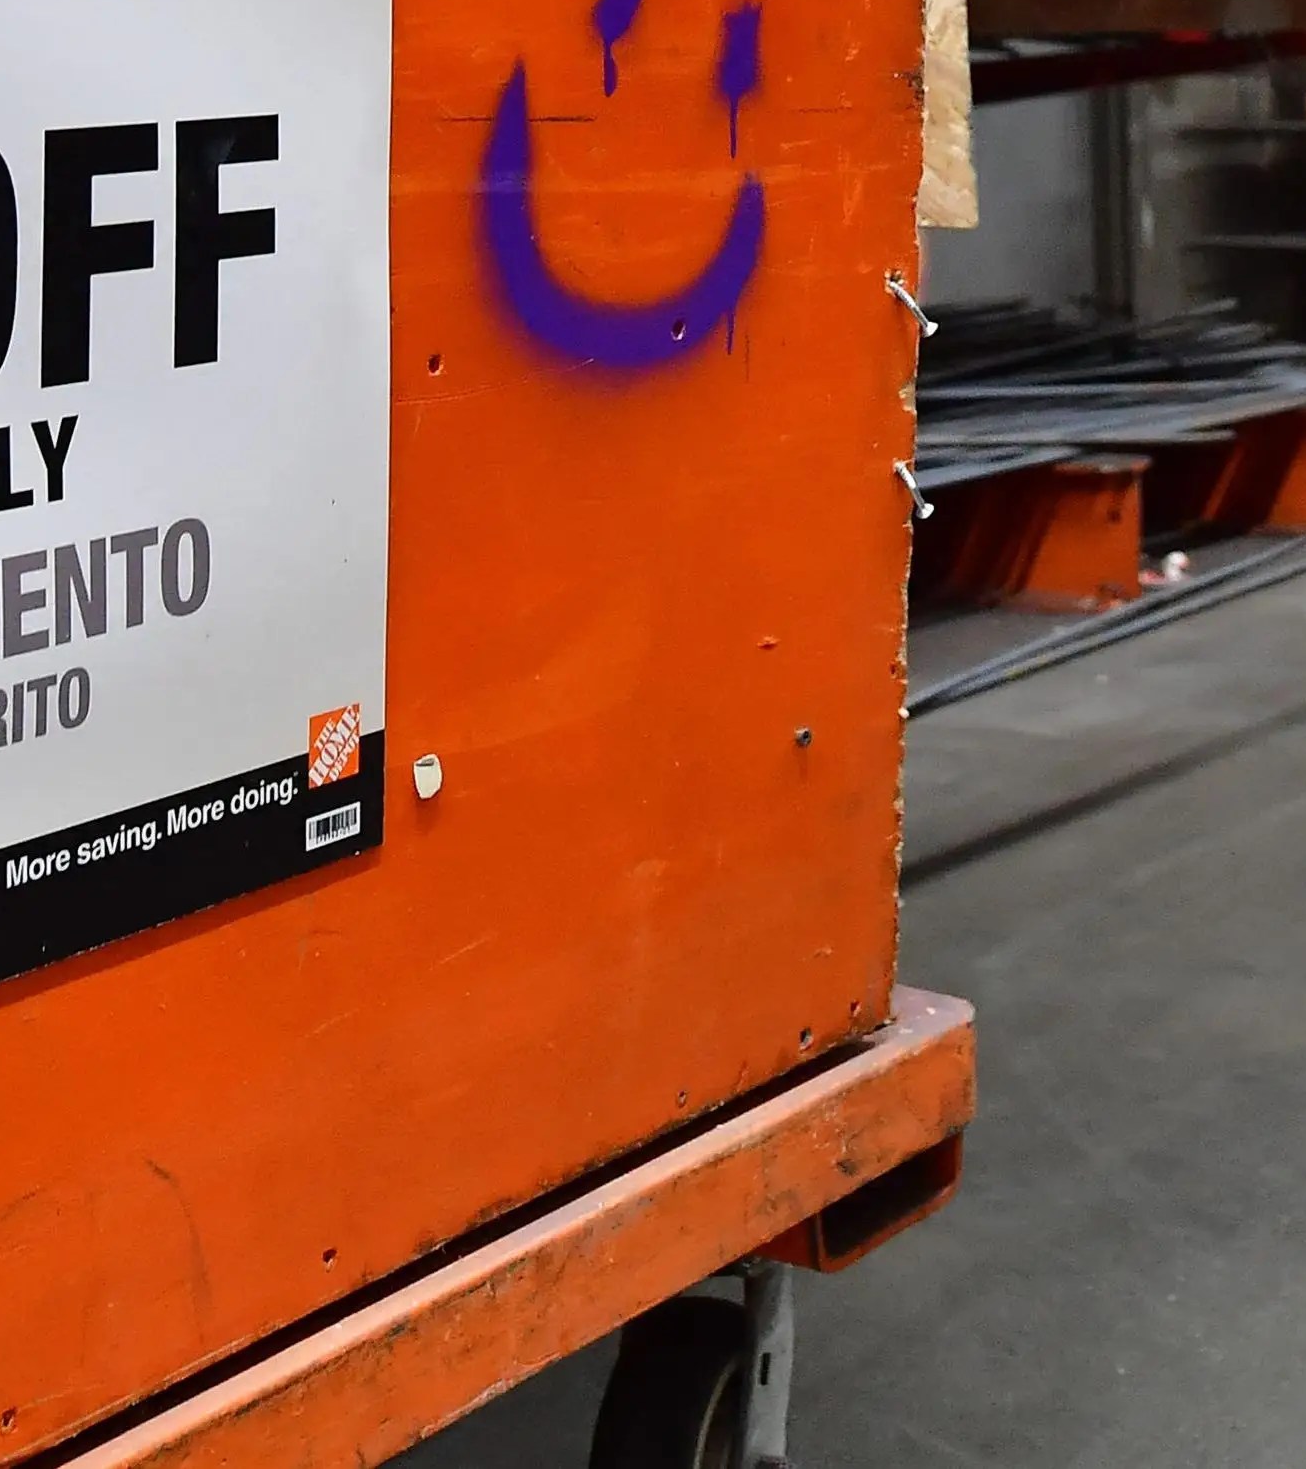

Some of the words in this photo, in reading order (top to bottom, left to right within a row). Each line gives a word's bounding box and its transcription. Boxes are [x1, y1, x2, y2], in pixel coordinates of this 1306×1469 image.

[309, 704, 361, 787] HOME
[314, 717, 336, 751] THE
[328, 731, 361, 782] DEPOT
[6, 849, 70, 889] More
[77, 819, 163, 867] saving.
[166, 797, 225, 837] More
[230, 774, 299, 815] doing.
